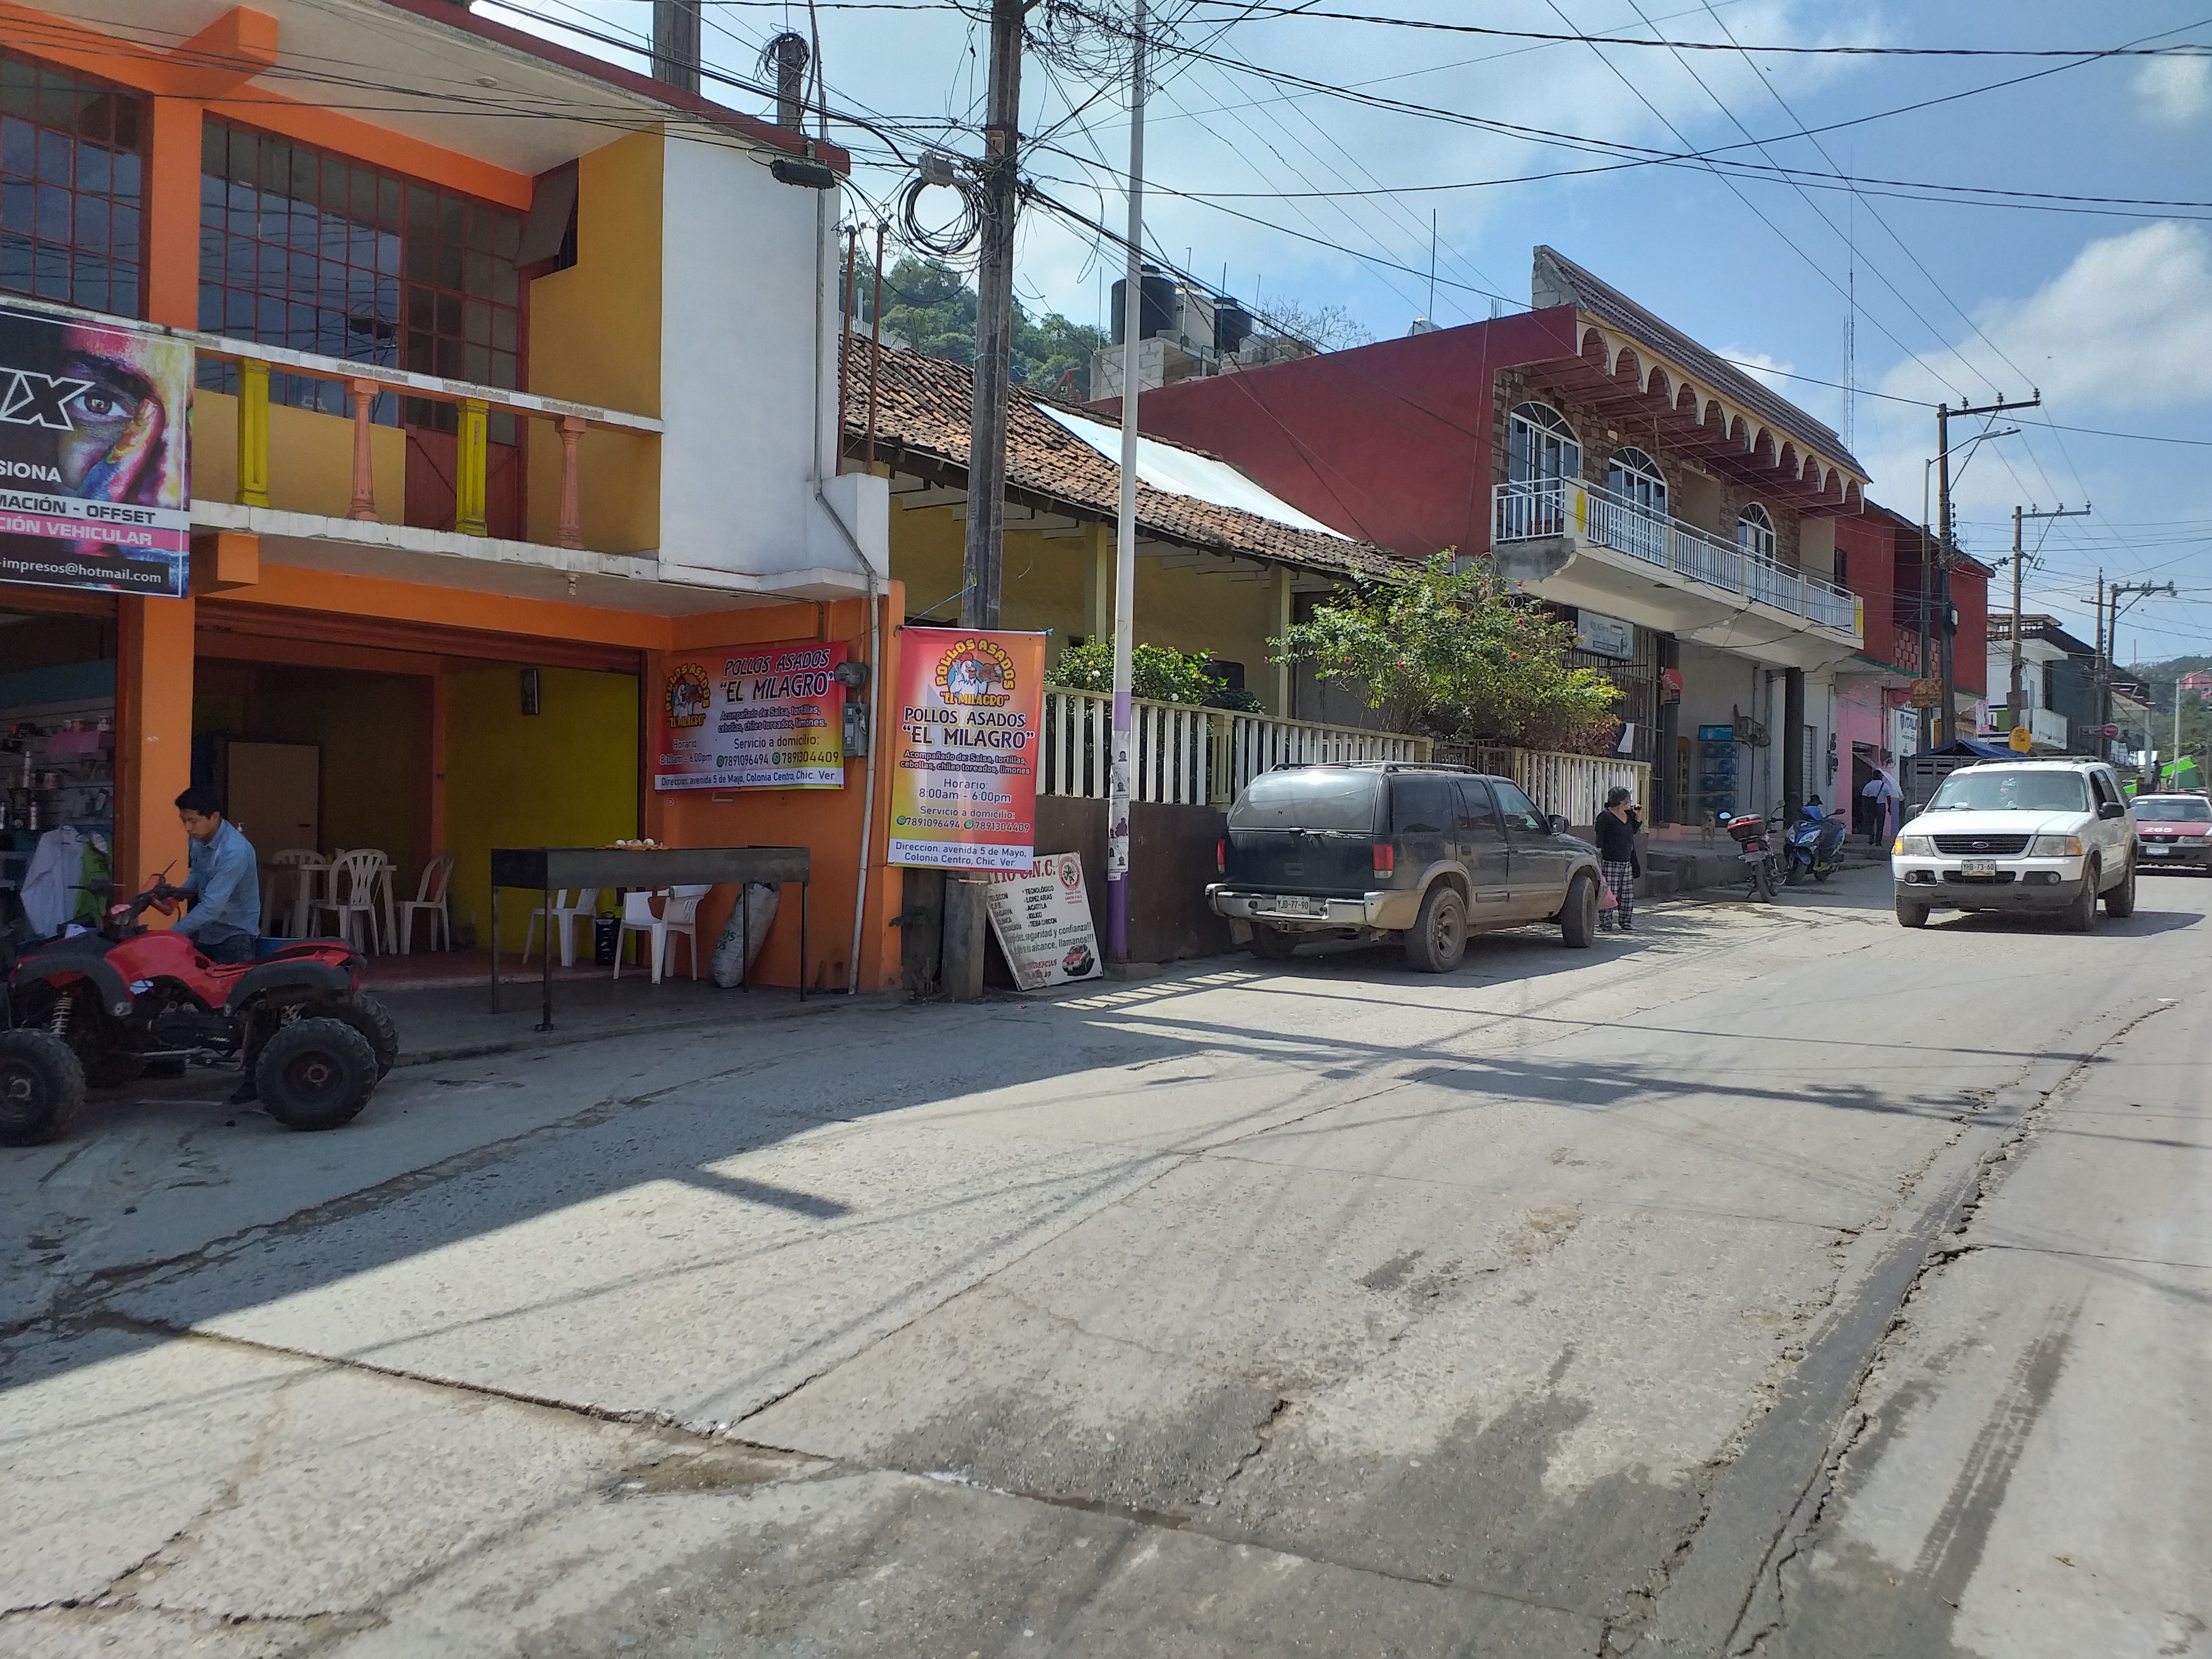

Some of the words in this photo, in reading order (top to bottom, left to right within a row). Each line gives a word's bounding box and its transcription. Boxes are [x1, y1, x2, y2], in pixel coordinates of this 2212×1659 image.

[0, 367, 97, 431] X
[86, 505, 156, 524] OFFSET
[47, 522, 152, 545] VEHICULAR
[724, 656, 772, 677] POLLOS
[776, 649, 831, 672] ASADOS
[935, 638, 975, 686] POLLOS
[977, 639, 1015, 690] ASADOS
[689, 663, 711, 708] ASADOS
[720, 708, 758, 721] Acompañado
[769, 706, 790, 717] Salsa,
[791, 704, 820, 715] tortillas,
[905, 707, 958, 724] POLLOS
[966, 711, 1027, 728] ASADOS
[718, 722, 744, 733] cebollas,
[744, 721, 762, 731] chiles
[763, 719, 794, 730] toreados,
[796, 718, 827, 728] limones.
[673, 739, 698, 750] Horario:
[734, 737, 766, 750] Servicio
[769, 739, 774, 747] a
[777, 734, 820, 747] domicilio:
[660, 754, 683, 765] 8:00am
[689, 752, 712, 764] 6:00pm
[724, 753, 768, 767] 7891096494
[782, 751, 839, 764] 7891304409
[904, 750, 955, 761] Acompañado
[956, 753, 968, 761] de:
[969, 754, 994, 764] Salsa,
[995, 756, 1027, 765] tortillas,
[900, 760, 936, 771] cebollas,
[962, 765, 999, 774] toreados,
[713, 775, 717, 783] 5
[719, 775, 726, 783] de
[728, 774, 745, 784] Mayo,
[746, 773, 771, 782] Colonia
[773, 772, 795, 781] Centro,
[944, 778, 988, 790] Horario:
[919, 788, 959, 800] 8:00am
[972, 791, 1011, 804] 6:00pm
[920, 806, 958, 817] Servicio
[970, 809, 1015, 819] domicilio:
[906, 817, 960, 828] 7891096494
[975, 821, 1030, 833] 7891304409
[905, 852, 938, 863] Colonia
[941, 855, 973, 865] Centro,
[943, 846, 977, 855] avenida
[988, 847, 999, 856] de
[1002, 848, 1027, 858] Mayo,
[1025, 885, 1055, 894] TECNOLÓGICO
[1040, 893, 1053, 901] ARIAS
[1277, 900, 1308, 909] YJD-77-90
[1025, 928, 1052, 942] seguridad
[1053, 929, 1057, 938] y
[1058, 921, 1092, 936] confianza!!
[1032, 941, 1057, 952] alcance,
[1058, 933, 1094, 948] llamanos!!!
